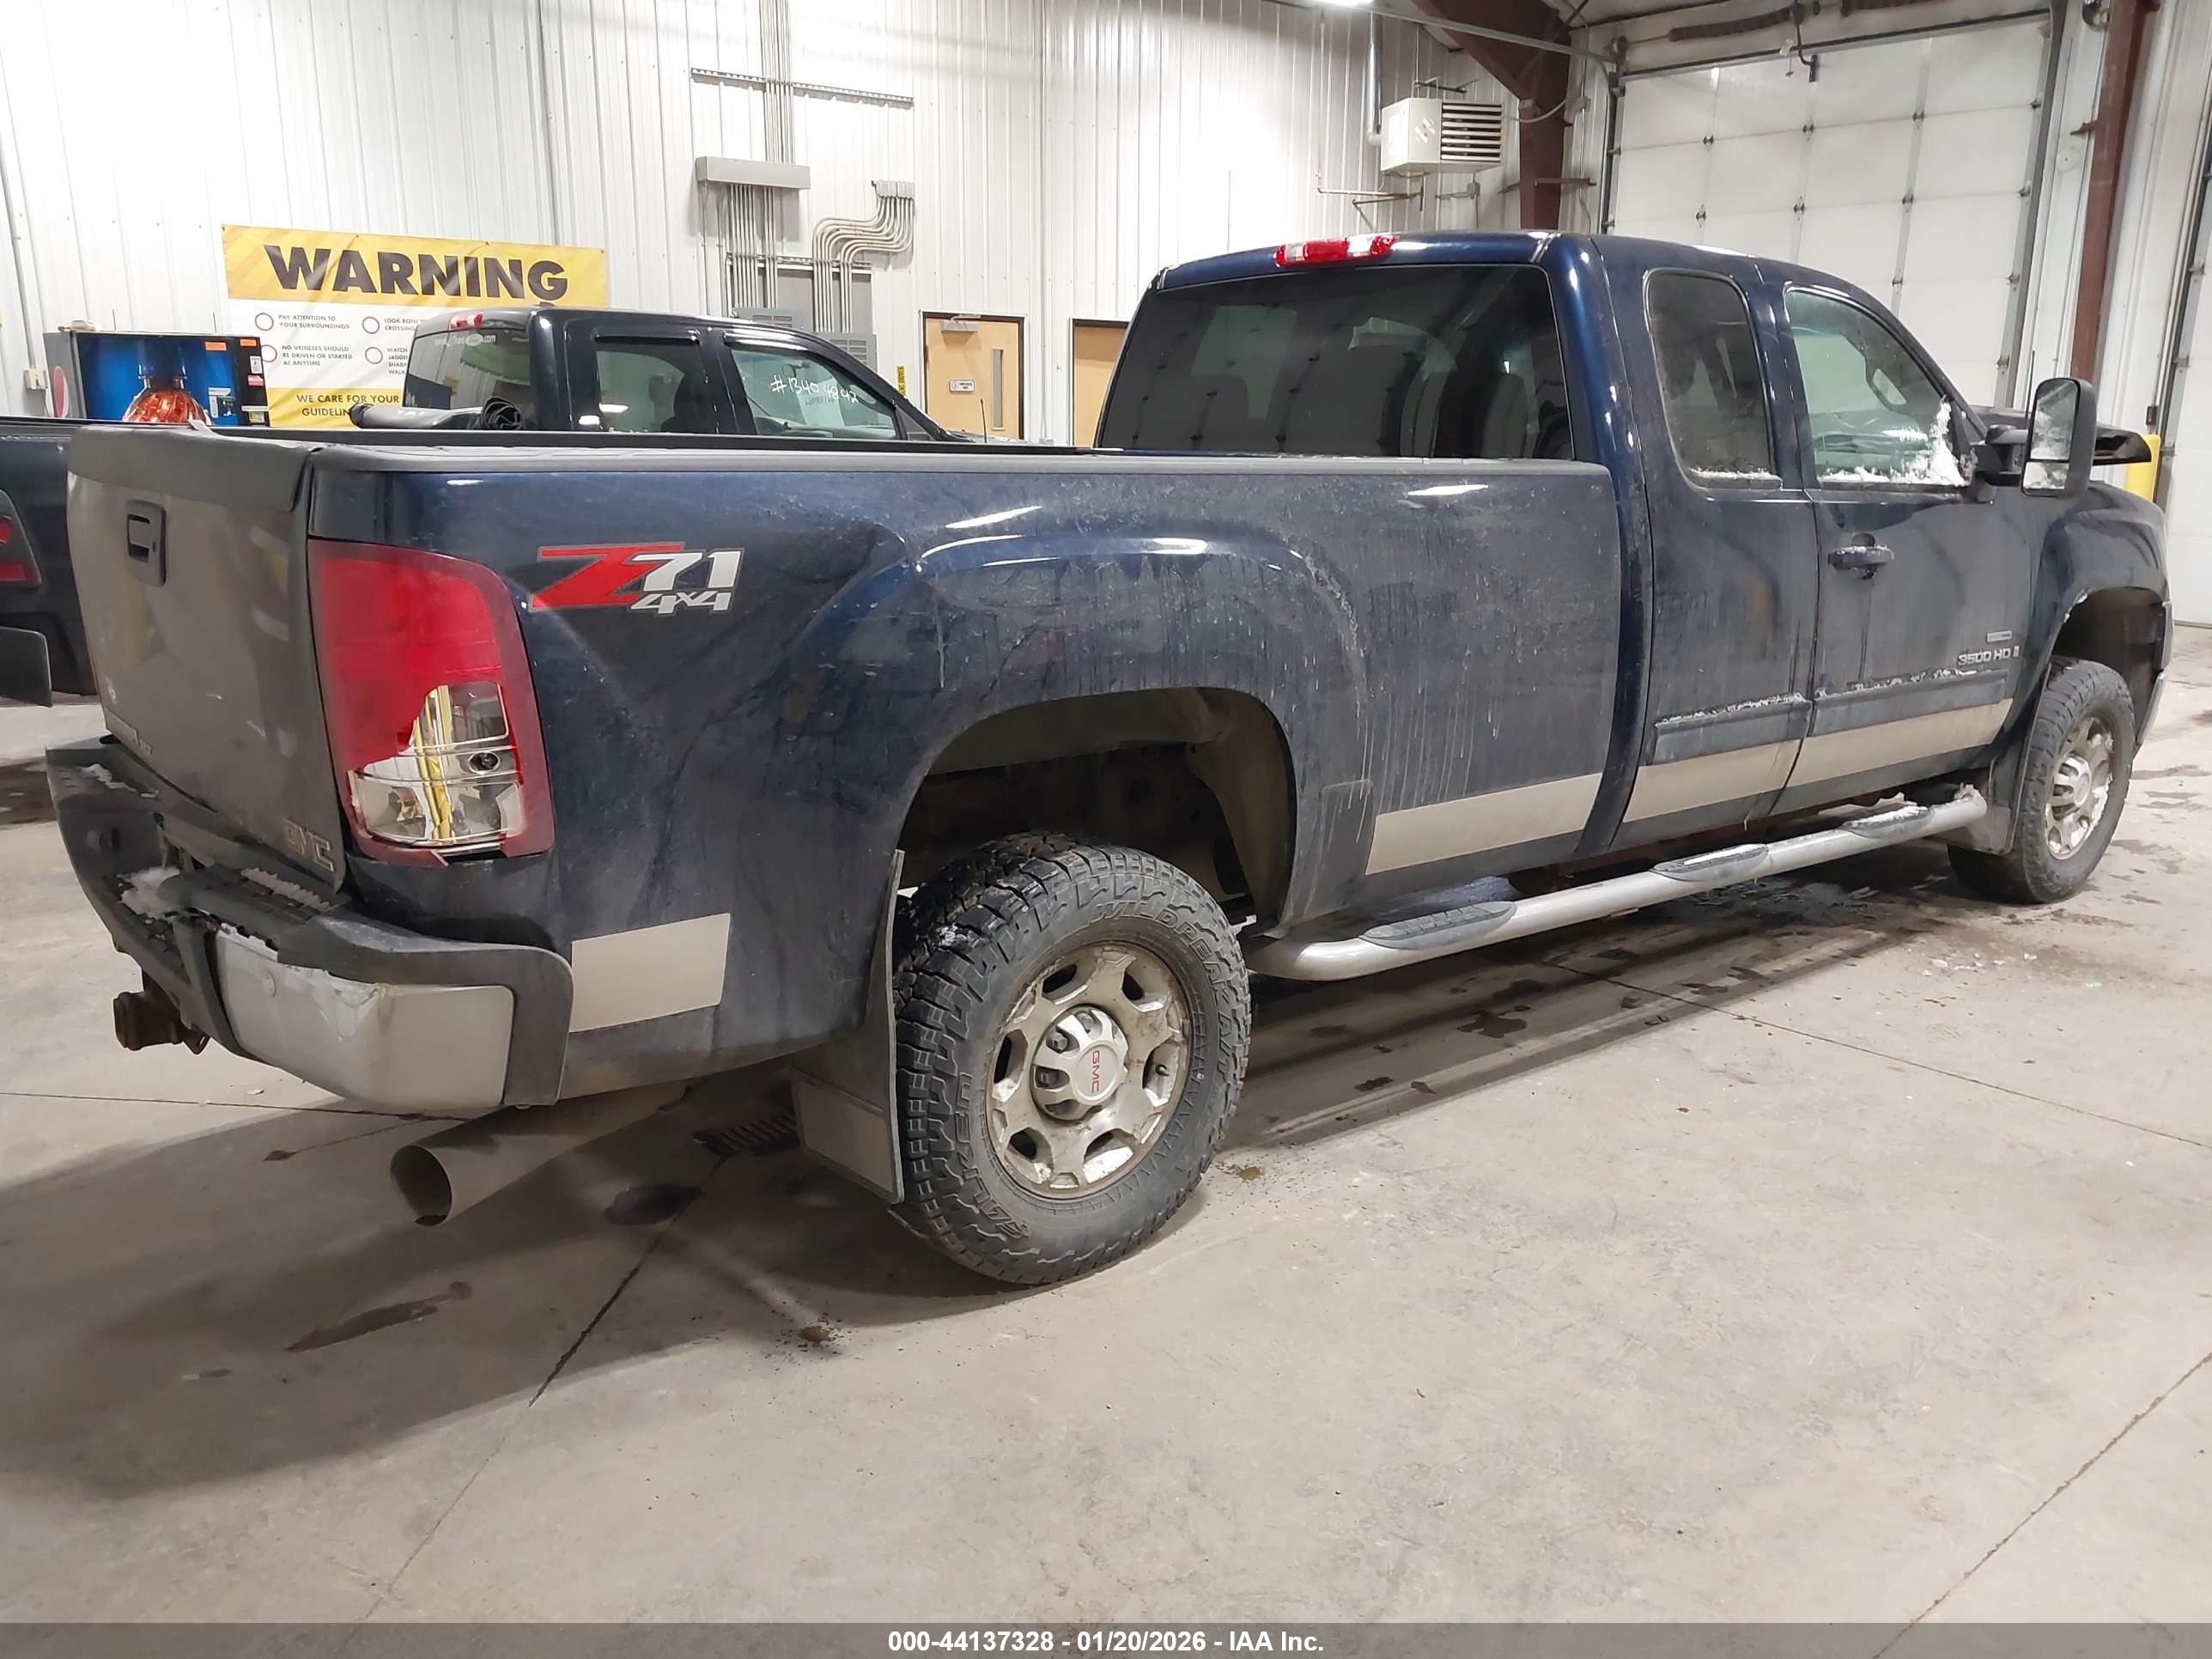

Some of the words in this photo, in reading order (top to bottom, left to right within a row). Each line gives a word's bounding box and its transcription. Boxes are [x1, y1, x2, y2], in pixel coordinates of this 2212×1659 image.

[264, 245, 568, 301] WARNING
[372, 395, 399, 404] YOUR
[529, 542, 744, 612] Z71
[1091, 1050, 1100, 1094] GMC
